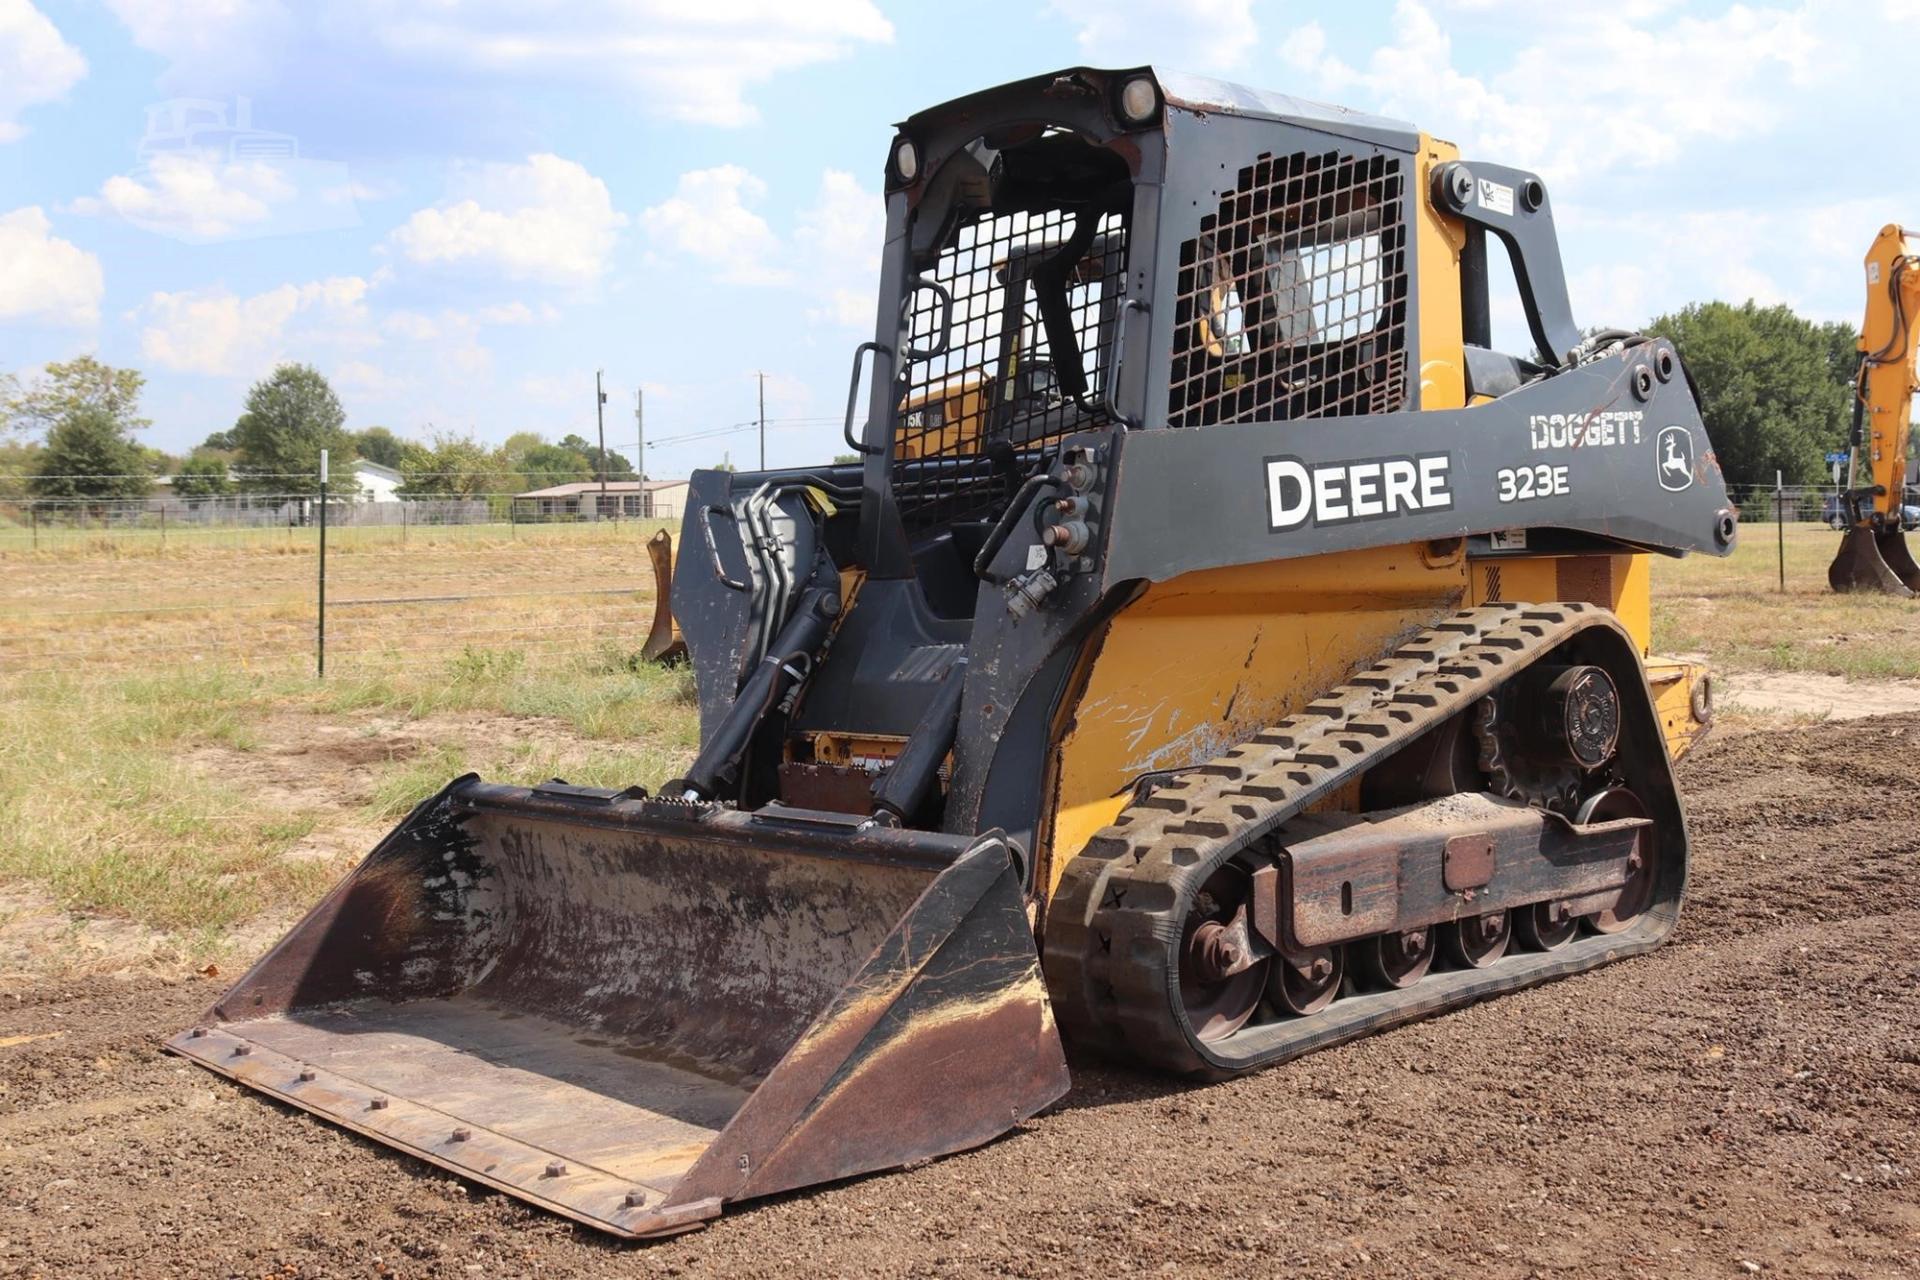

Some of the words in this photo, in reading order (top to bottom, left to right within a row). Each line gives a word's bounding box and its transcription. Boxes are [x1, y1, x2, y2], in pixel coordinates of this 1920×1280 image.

[1530, 410, 1643, 450] DOGGETT
[1267, 456, 1450, 528] DEERE
[1497, 465, 1570, 501] 323E
